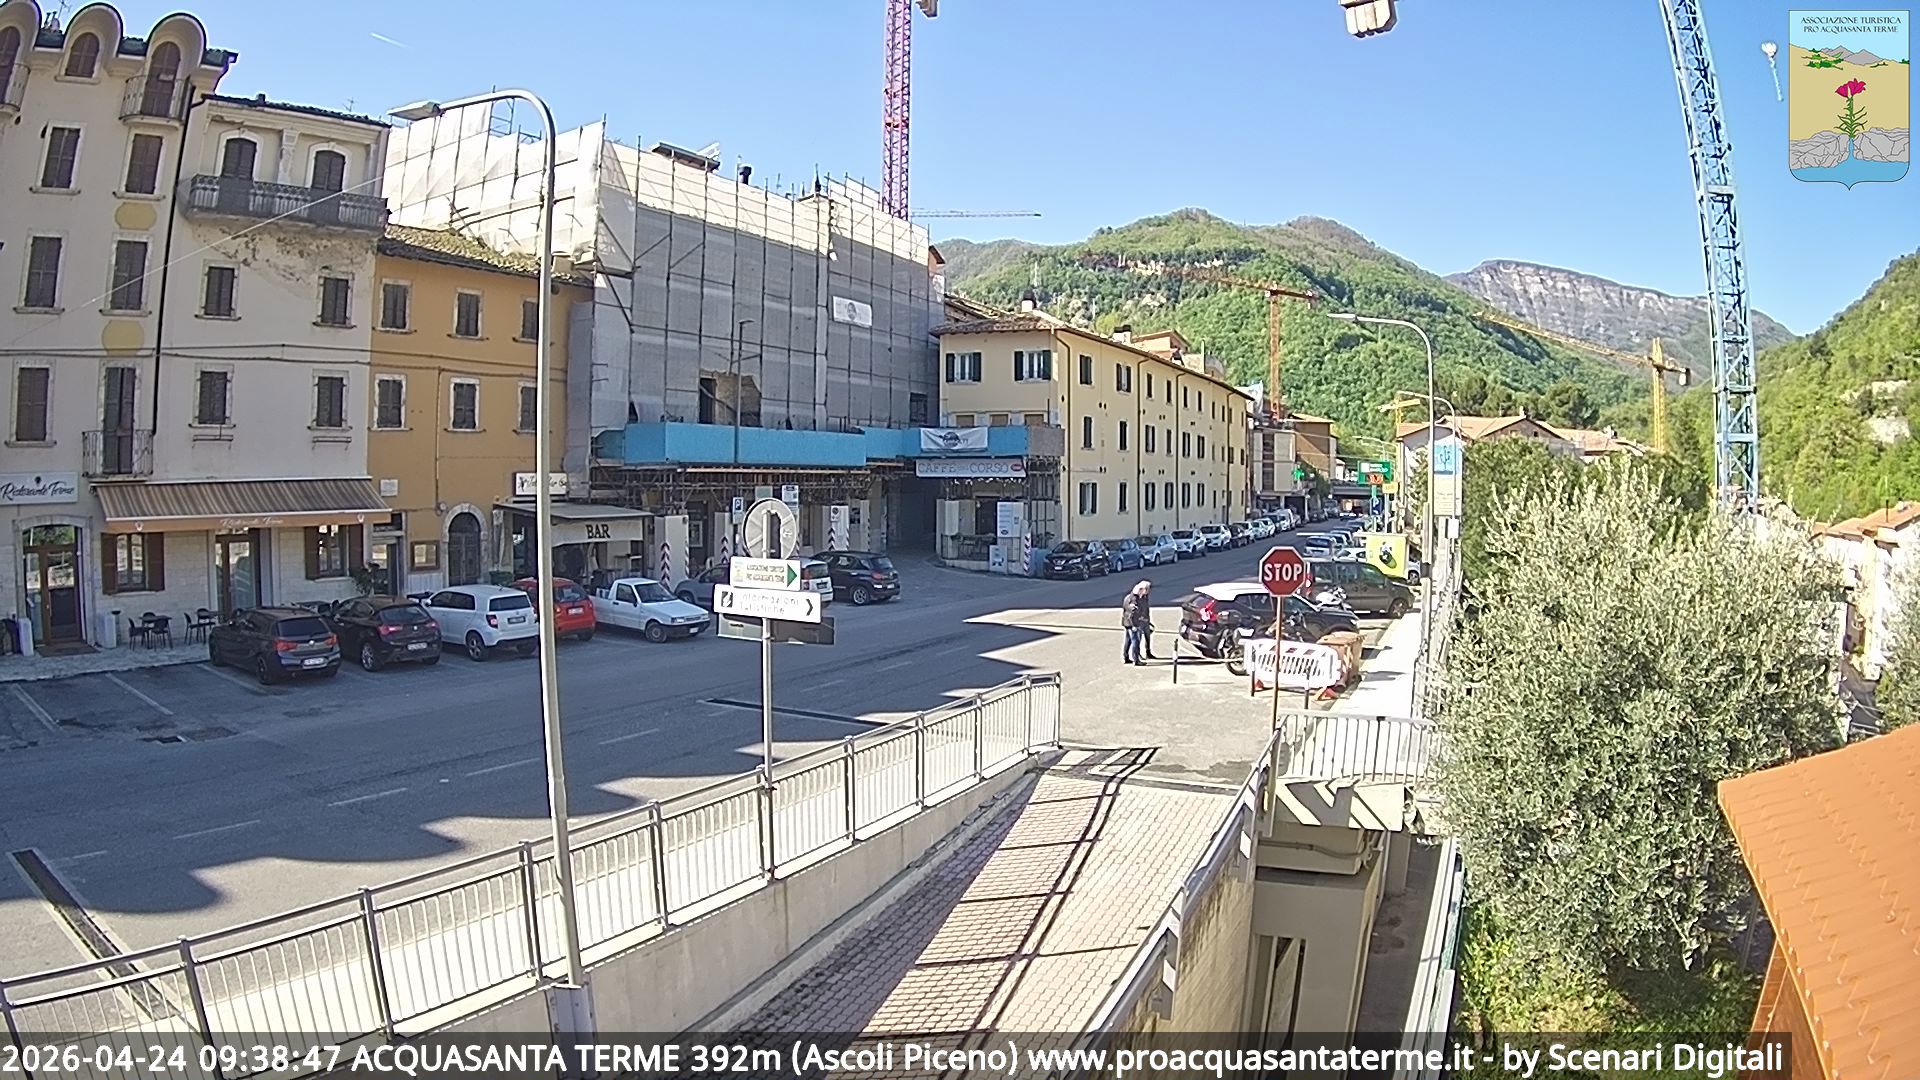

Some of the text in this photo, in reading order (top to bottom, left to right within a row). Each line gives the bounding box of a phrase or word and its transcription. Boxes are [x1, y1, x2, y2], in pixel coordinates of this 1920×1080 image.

[969, 463, 1009, 474] CORSO
[585, 523, 611, 539] BAR
[1263, 562, 1303, 582] STOP
